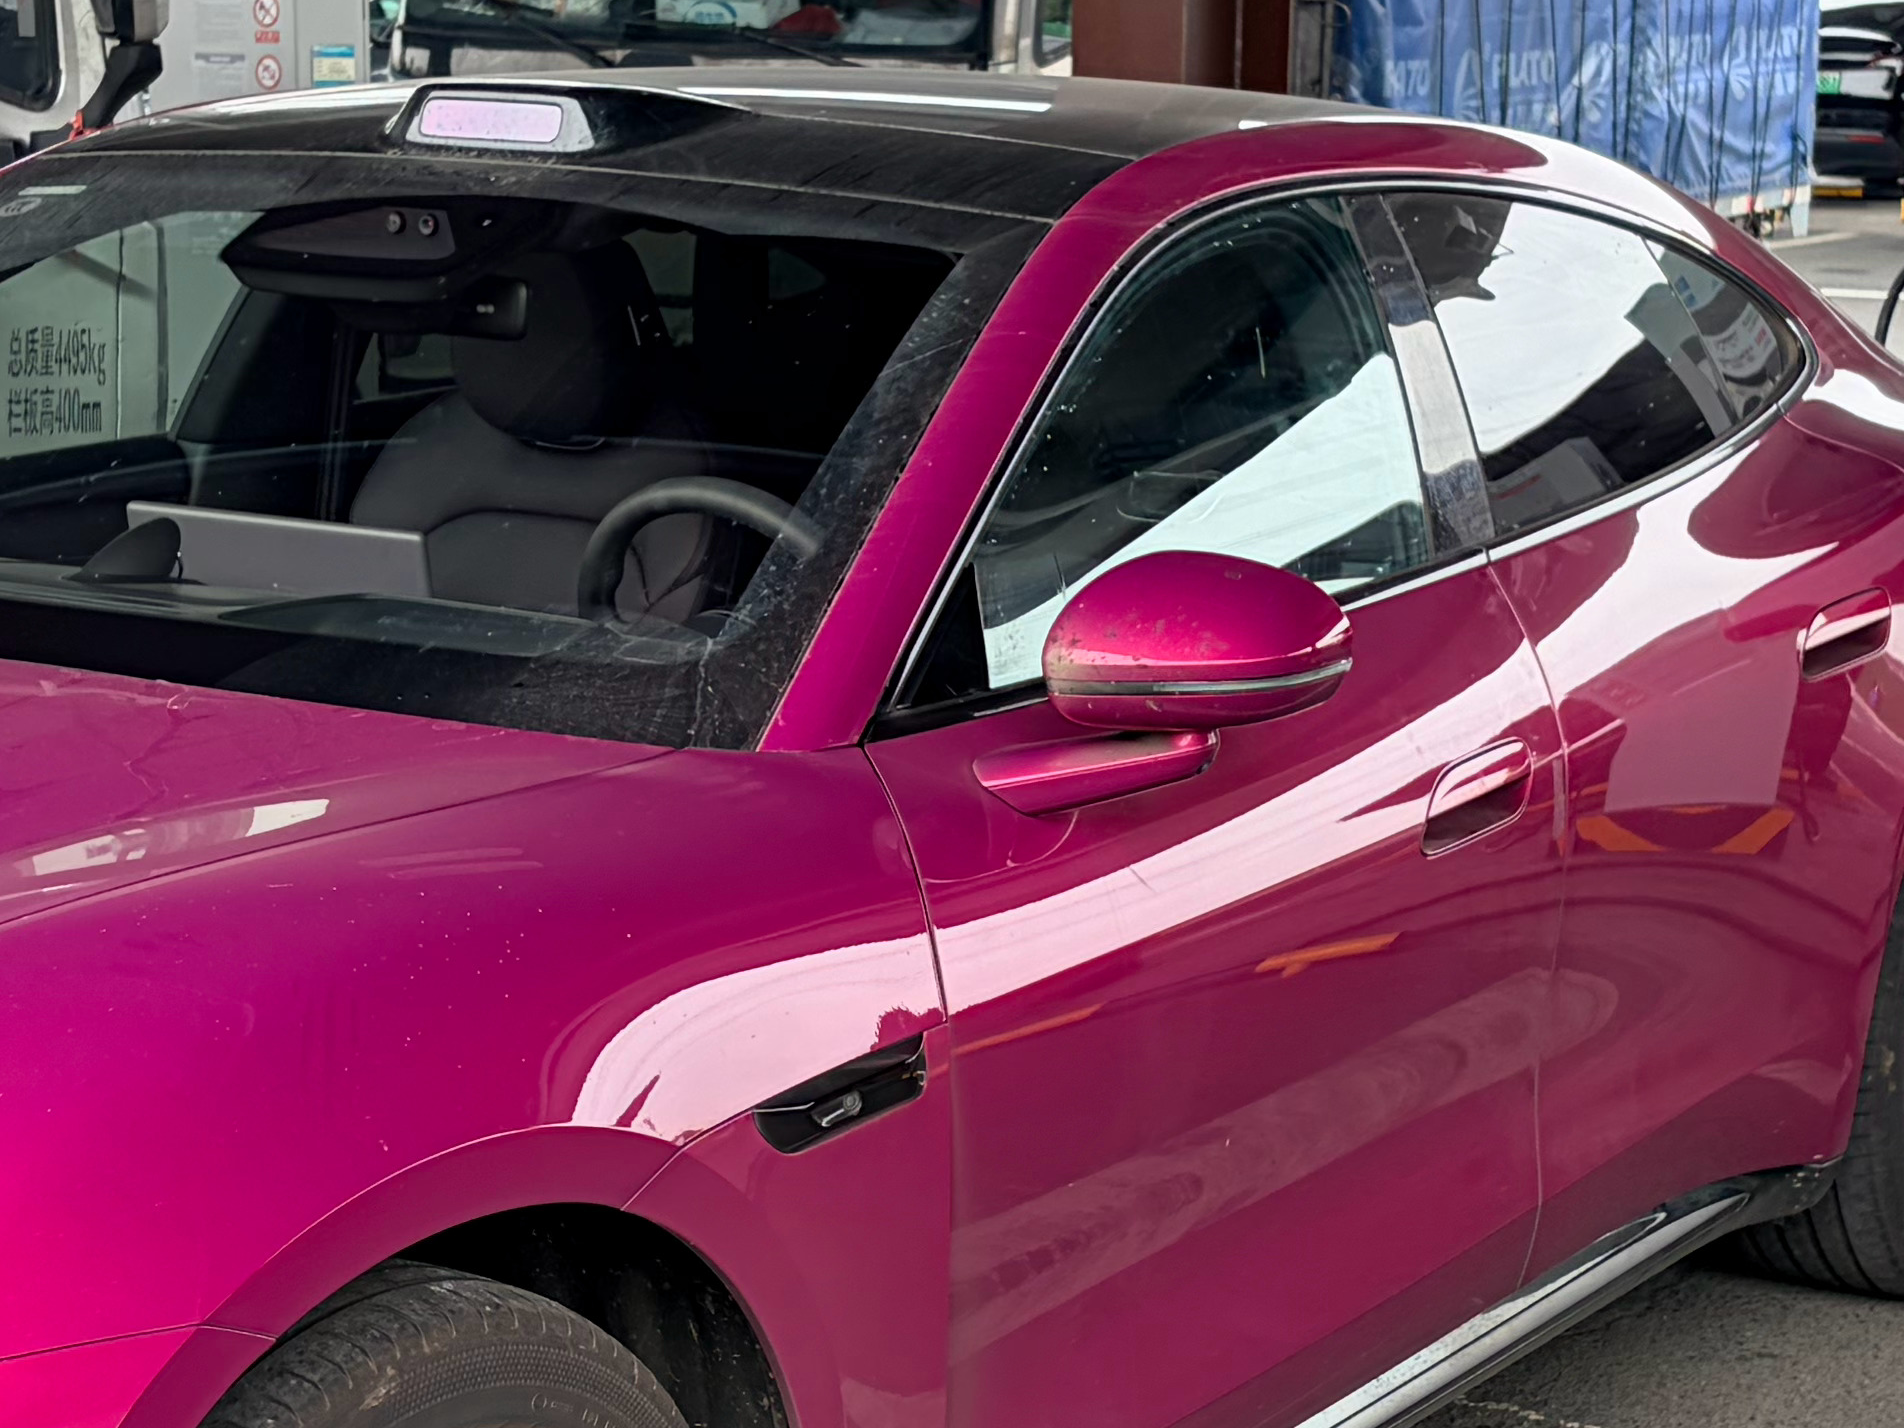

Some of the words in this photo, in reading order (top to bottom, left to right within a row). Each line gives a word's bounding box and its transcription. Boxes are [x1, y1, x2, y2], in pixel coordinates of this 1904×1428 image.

[8, 325, 106, 386] 总质量4495kg
[7, 385, 102, 438] 栏板高400mm
